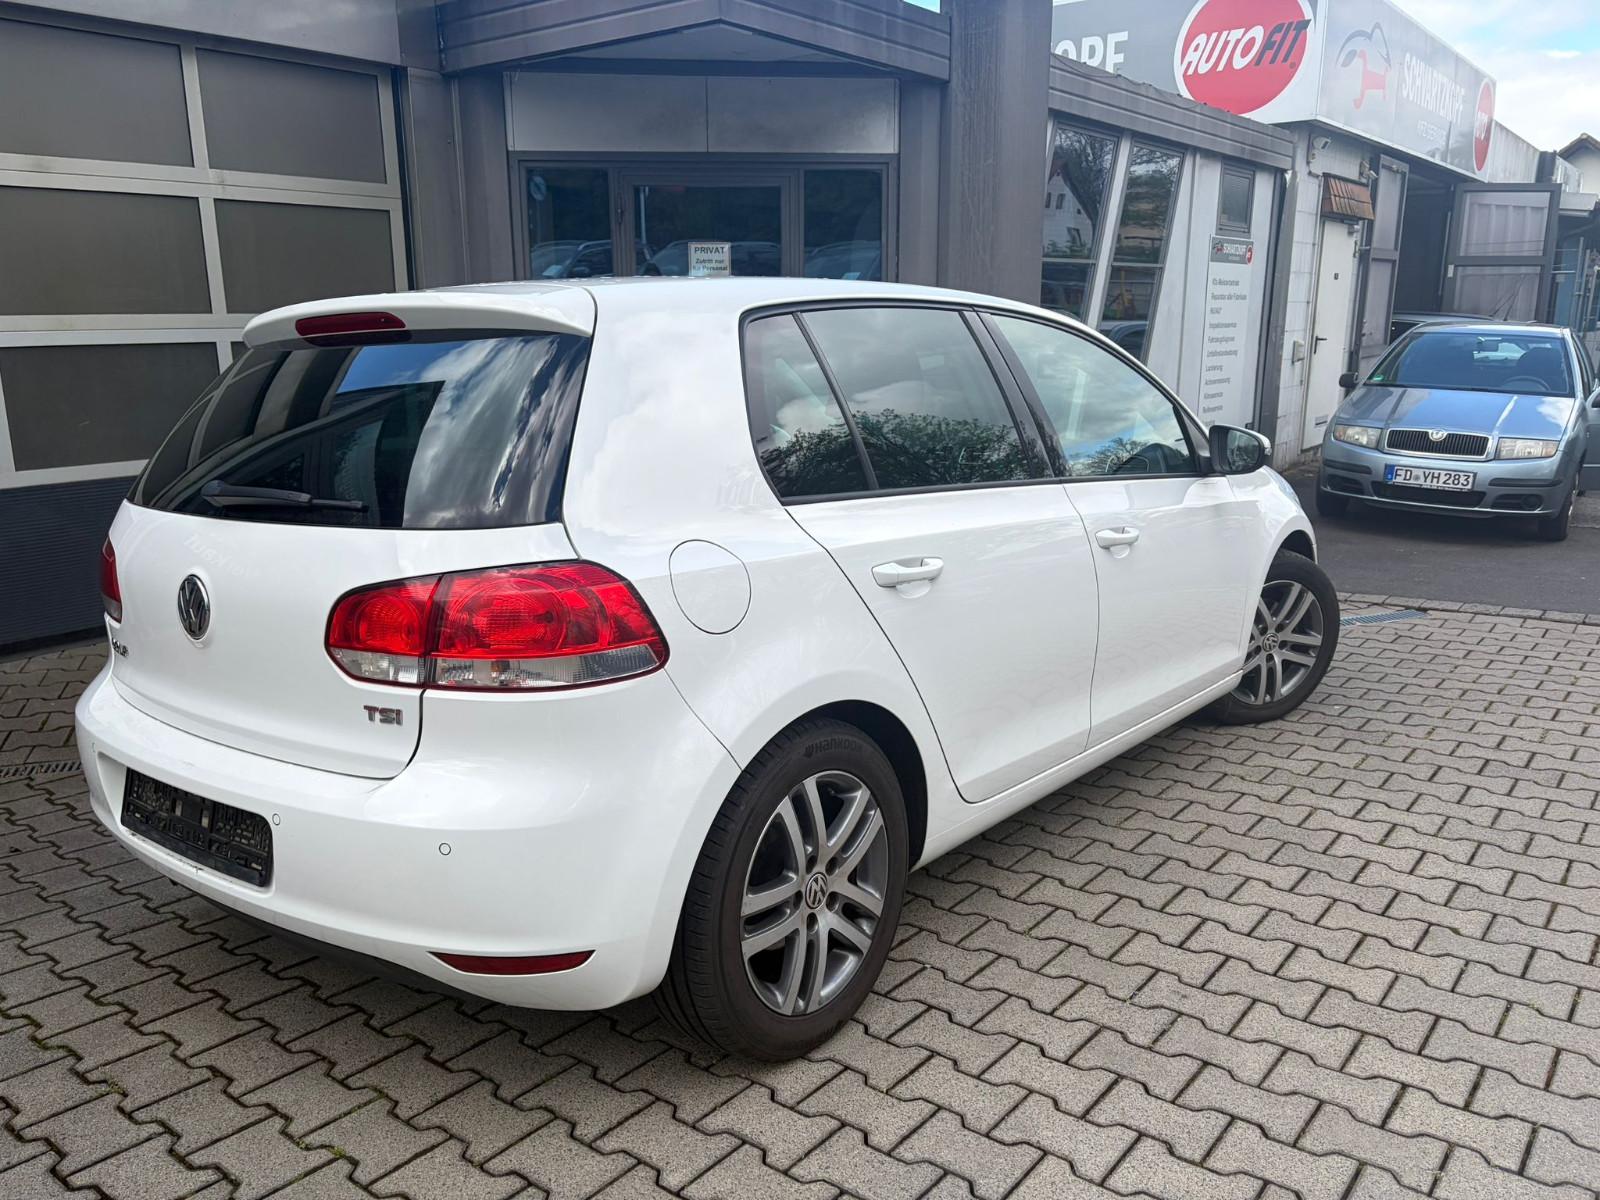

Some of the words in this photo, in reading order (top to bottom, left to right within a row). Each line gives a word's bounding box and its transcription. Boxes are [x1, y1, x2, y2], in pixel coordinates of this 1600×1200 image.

[1182, 19, 1312, 75] AUTOFIT
[694, 246, 725, 254] PRIVAT
[1394, 468, 1413, 481] FD
[1422, 470, 1441, 485] YH
[1442, 472, 1472, 487] 283
[363, 704, 404, 727] TSI
